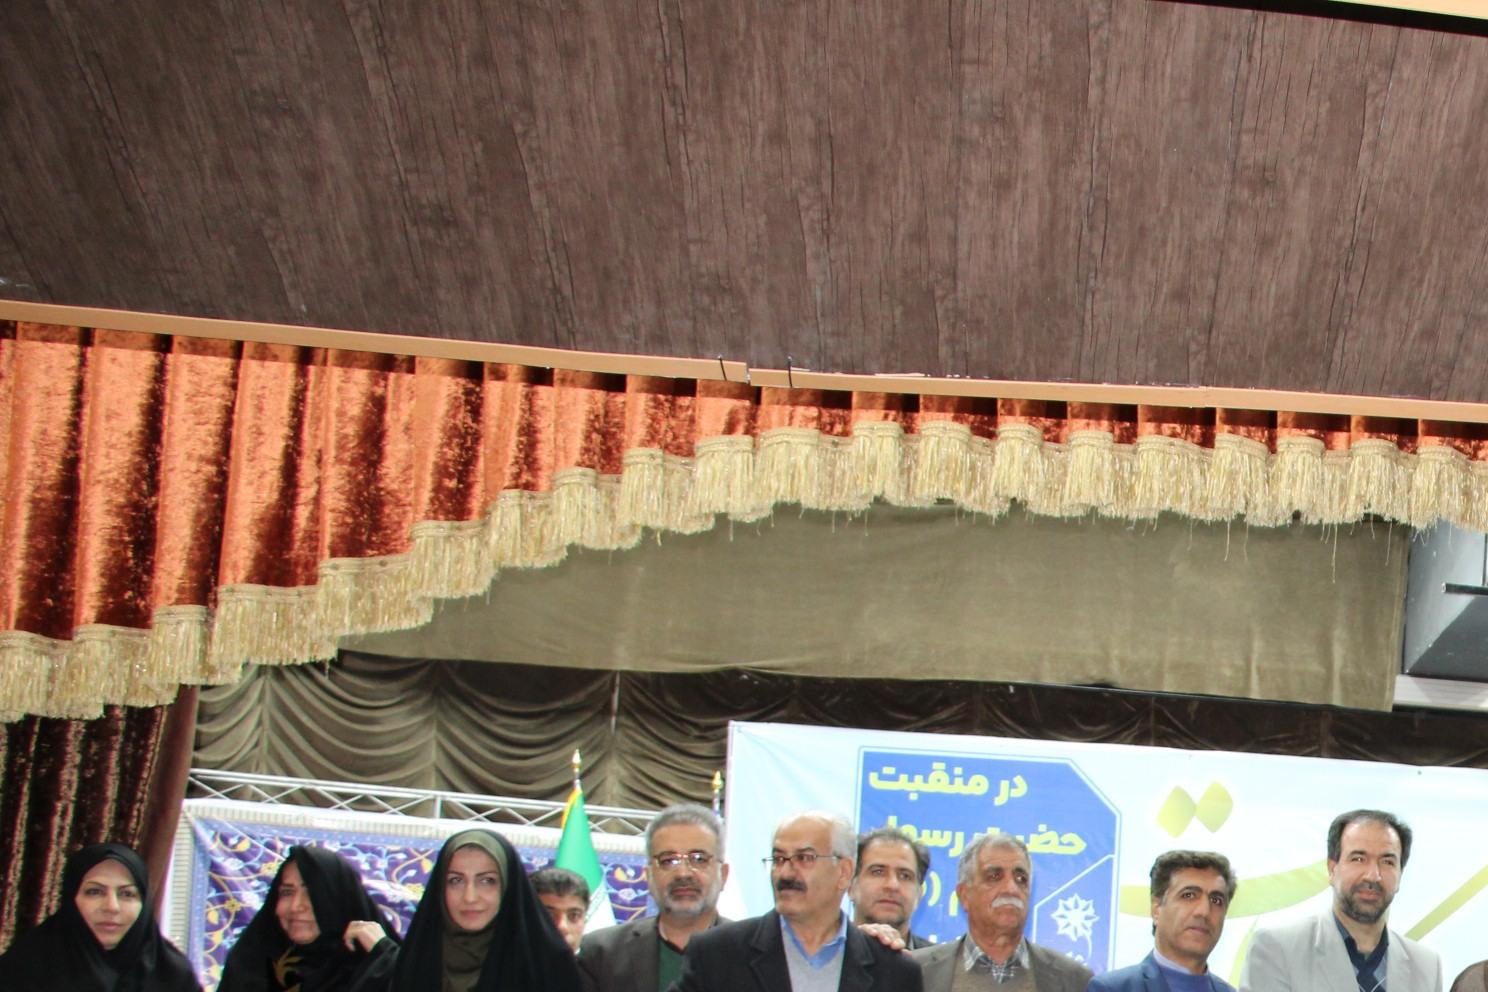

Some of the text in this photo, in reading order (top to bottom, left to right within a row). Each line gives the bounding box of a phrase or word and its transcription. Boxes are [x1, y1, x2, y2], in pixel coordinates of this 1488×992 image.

[868, 761, 1028, 806] در منقبت
[973, 823, 1088, 856] حض
